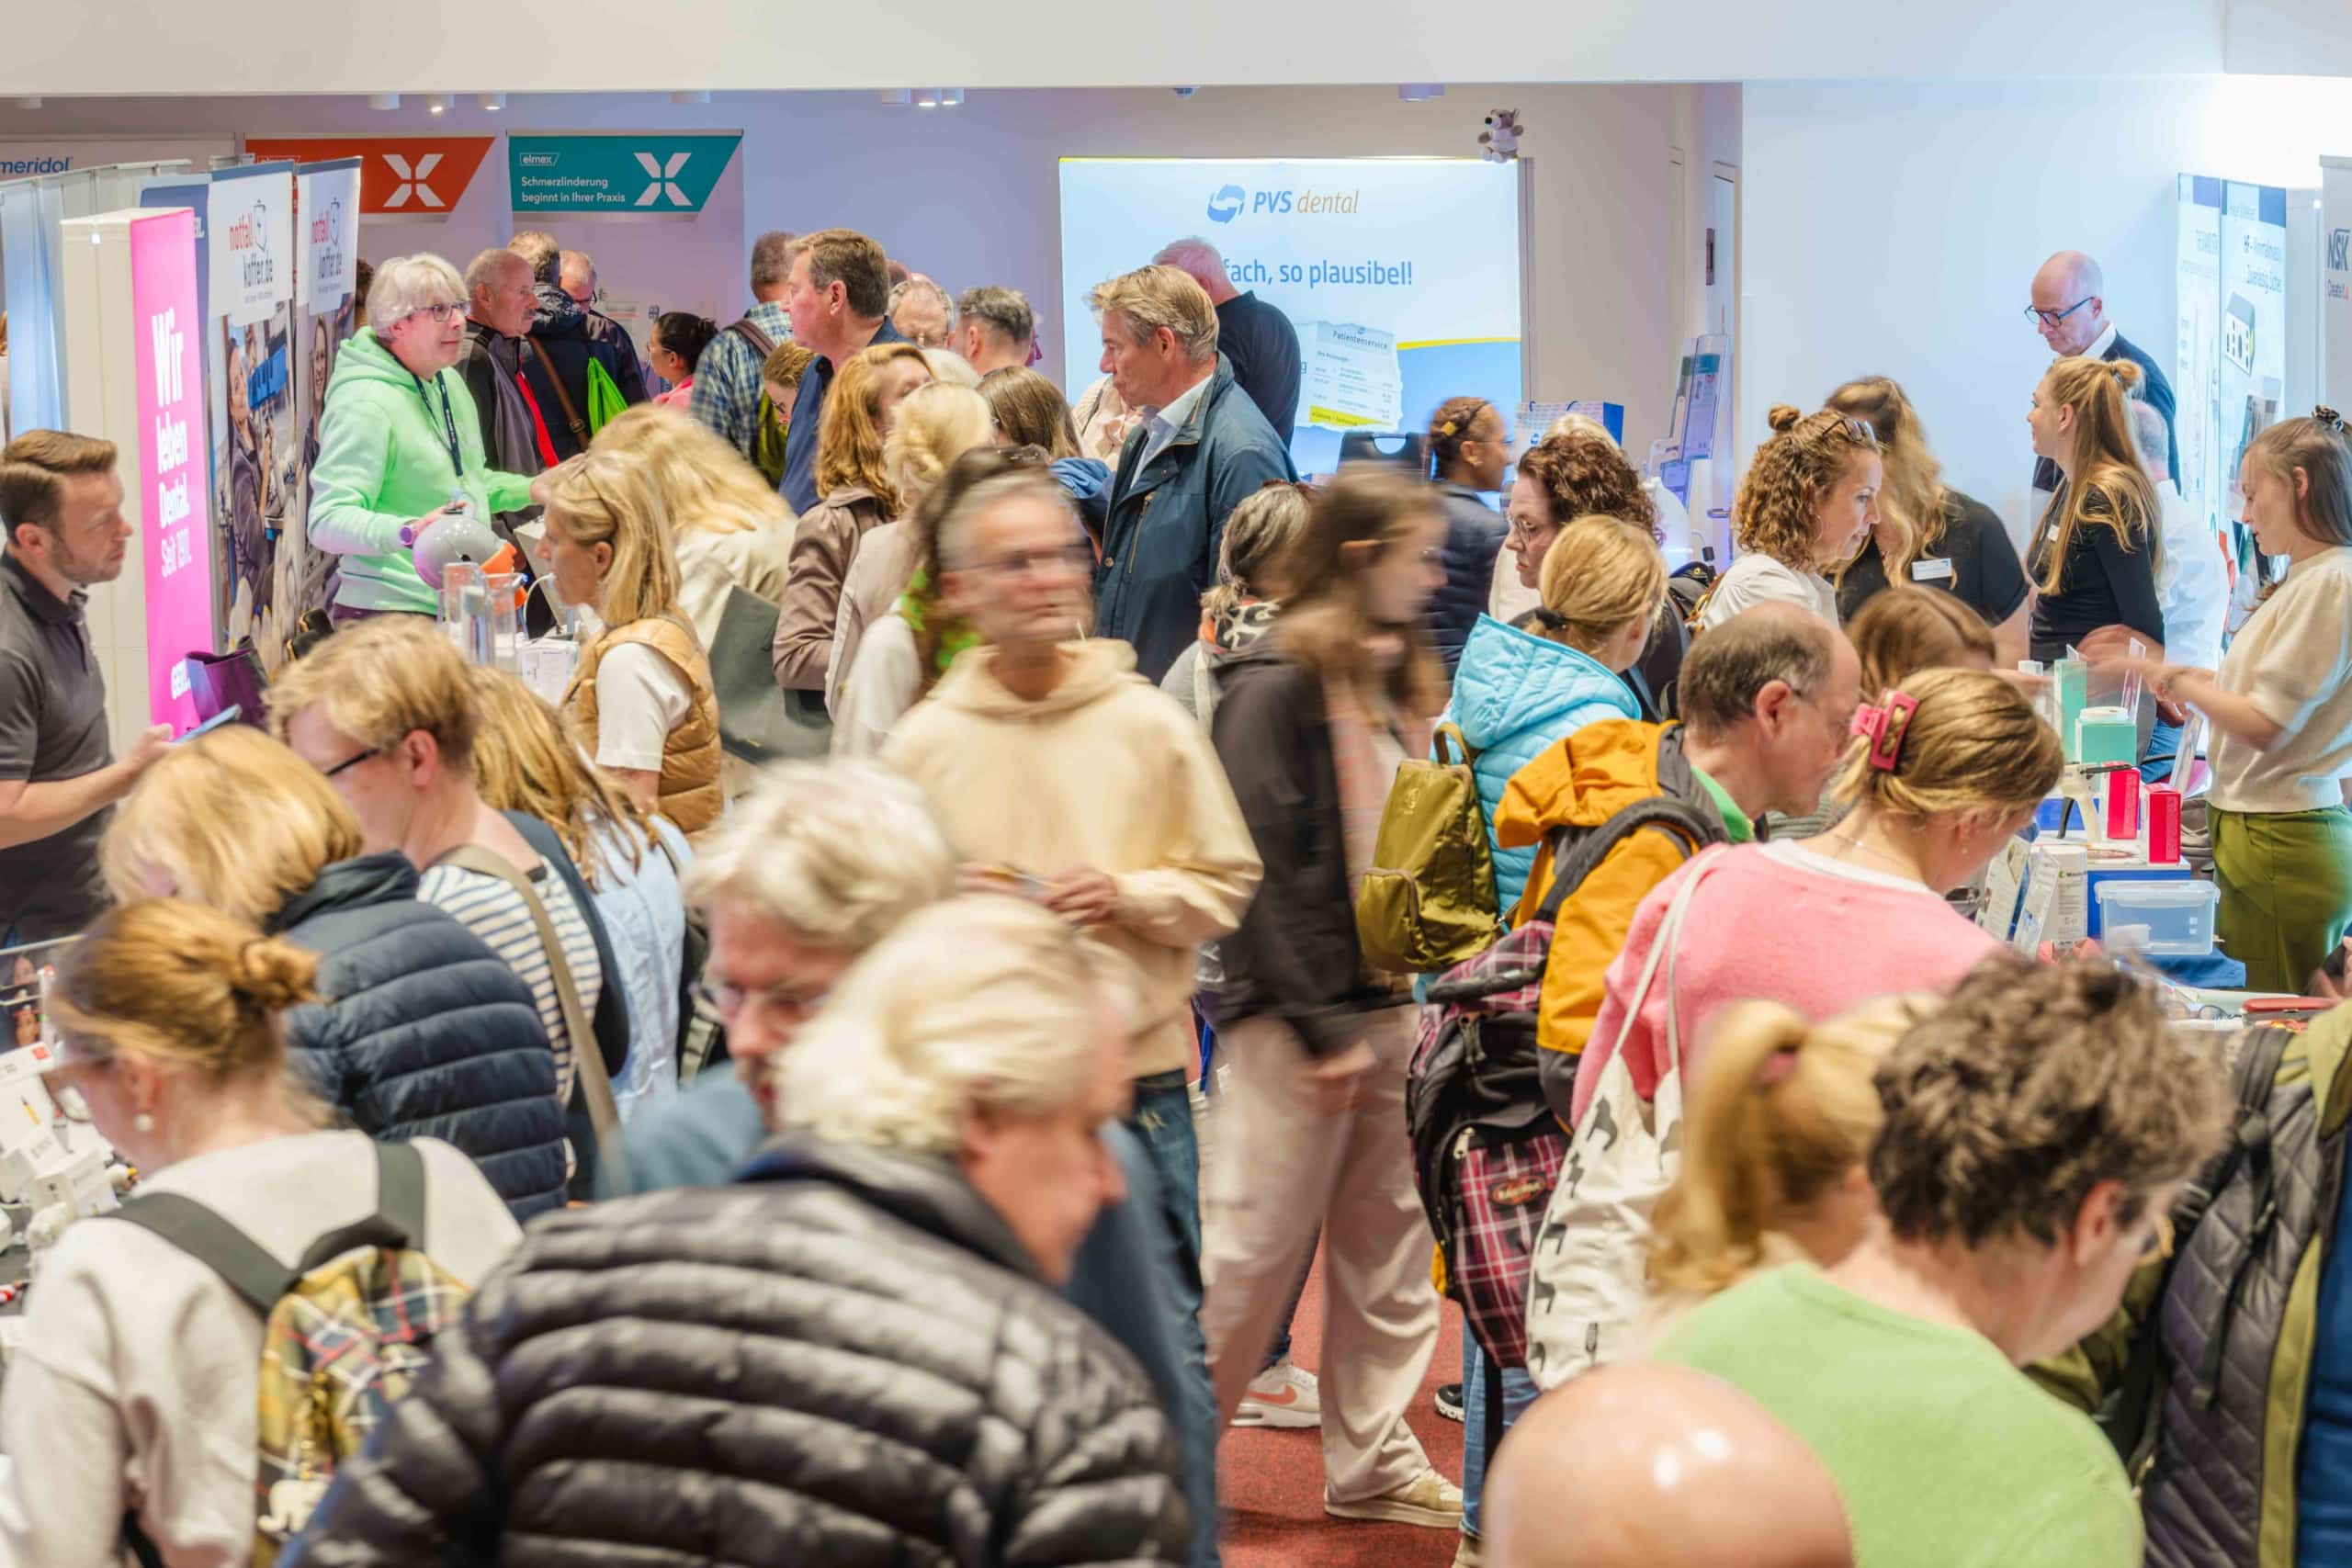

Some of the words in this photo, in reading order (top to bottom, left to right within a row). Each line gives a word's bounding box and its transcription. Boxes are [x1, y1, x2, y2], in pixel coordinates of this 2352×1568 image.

[522, 154, 552, 164] elmex
[521, 176, 608, 189] Schmerzlinderung
[521, 192, 559, 204] beginnt
[560, 192, 570, 202] in
[571, 192, 594, 202] Ihrer
[596, 192, 626, 202] Praxis
[1252, 190, 1293, 213] PVS
[1297, 189, 1359, 214] dental
[2327, 228, 2351, 272] NSK
[1224, 258, 1272, 285] fach,
[1279, 265, 1303, 283] so
[1308, 259, 1412, 288] plausibel!
[1332, 331, 1387, 350] Patientenservice
[151, 306, 185, 409] Wir
[155, 411, 188, 475] leben
